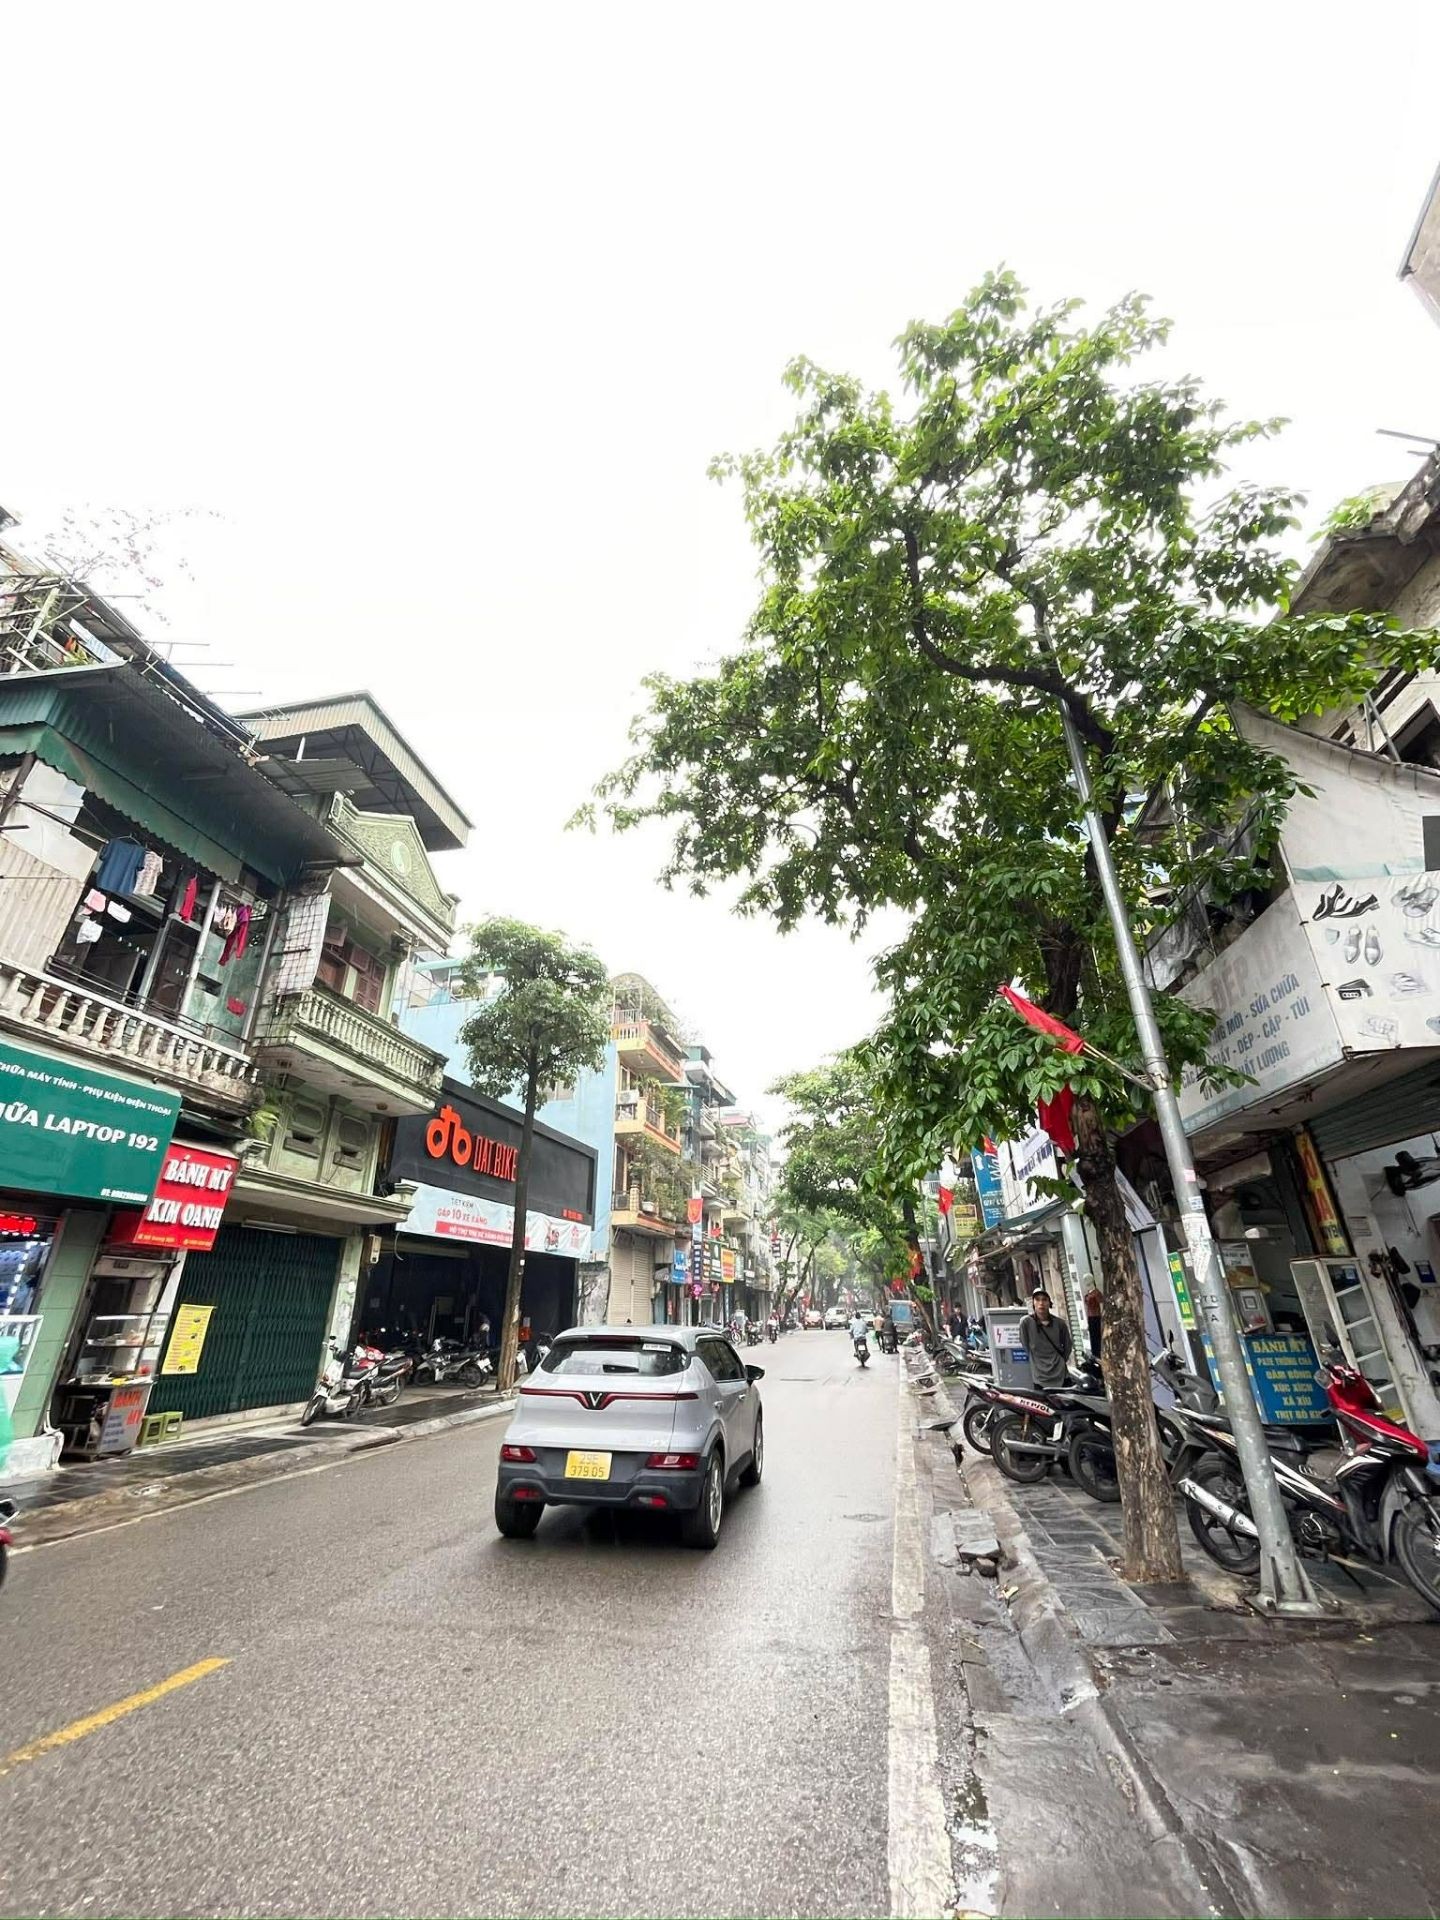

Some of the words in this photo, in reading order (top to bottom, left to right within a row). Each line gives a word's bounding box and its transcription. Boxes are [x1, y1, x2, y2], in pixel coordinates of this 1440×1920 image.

[1250, 992, 1271, 1018] SỬA
[1270, 973, 1300, 1004] CHỮA
[1256, 1041, 1291, 1071] LƯỢNG
[27, 1071, 52, 1083] MÁY
[53, 1077, 78, 1090] TÍNH
[83, 1085, 104, 1099] PHỤ
[147, 1103, 172, 1117] THOẠI
[44, 1114, 126, 1144] LAPTOP
[127, 1133, 159, 1152] 192
[164, 1154, 210, 1187] BÁNH
[146, 1197, 182, 1225] KIM
[181, 1203, 225, 1231] OANH
[1252, 1338, 1288, 1353] BÁNH
